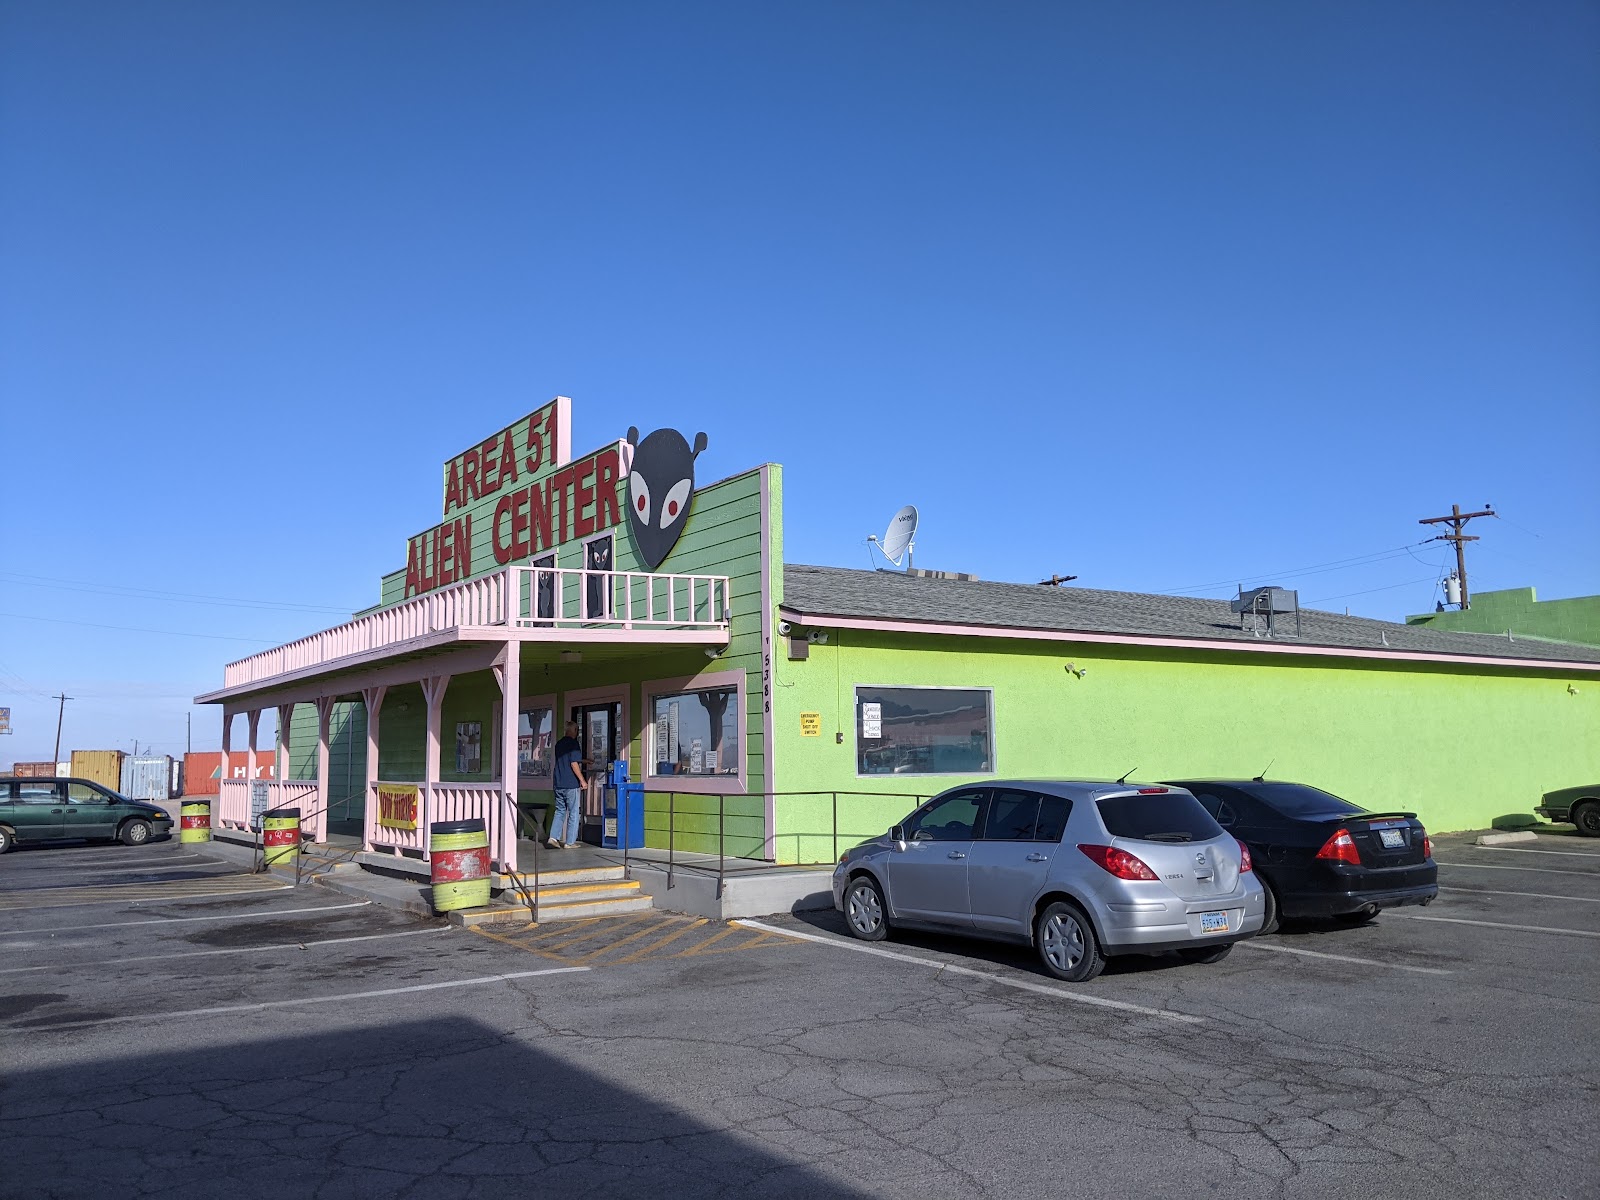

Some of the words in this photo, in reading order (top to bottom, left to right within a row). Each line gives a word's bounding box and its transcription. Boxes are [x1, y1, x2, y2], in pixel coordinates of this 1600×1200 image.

[404, 514, 472, 598] ALIEN
[492, 449, 621, 565] CENTER
[444, 430, 518, 515] AREA
[525, 405, 557, 474] 51
